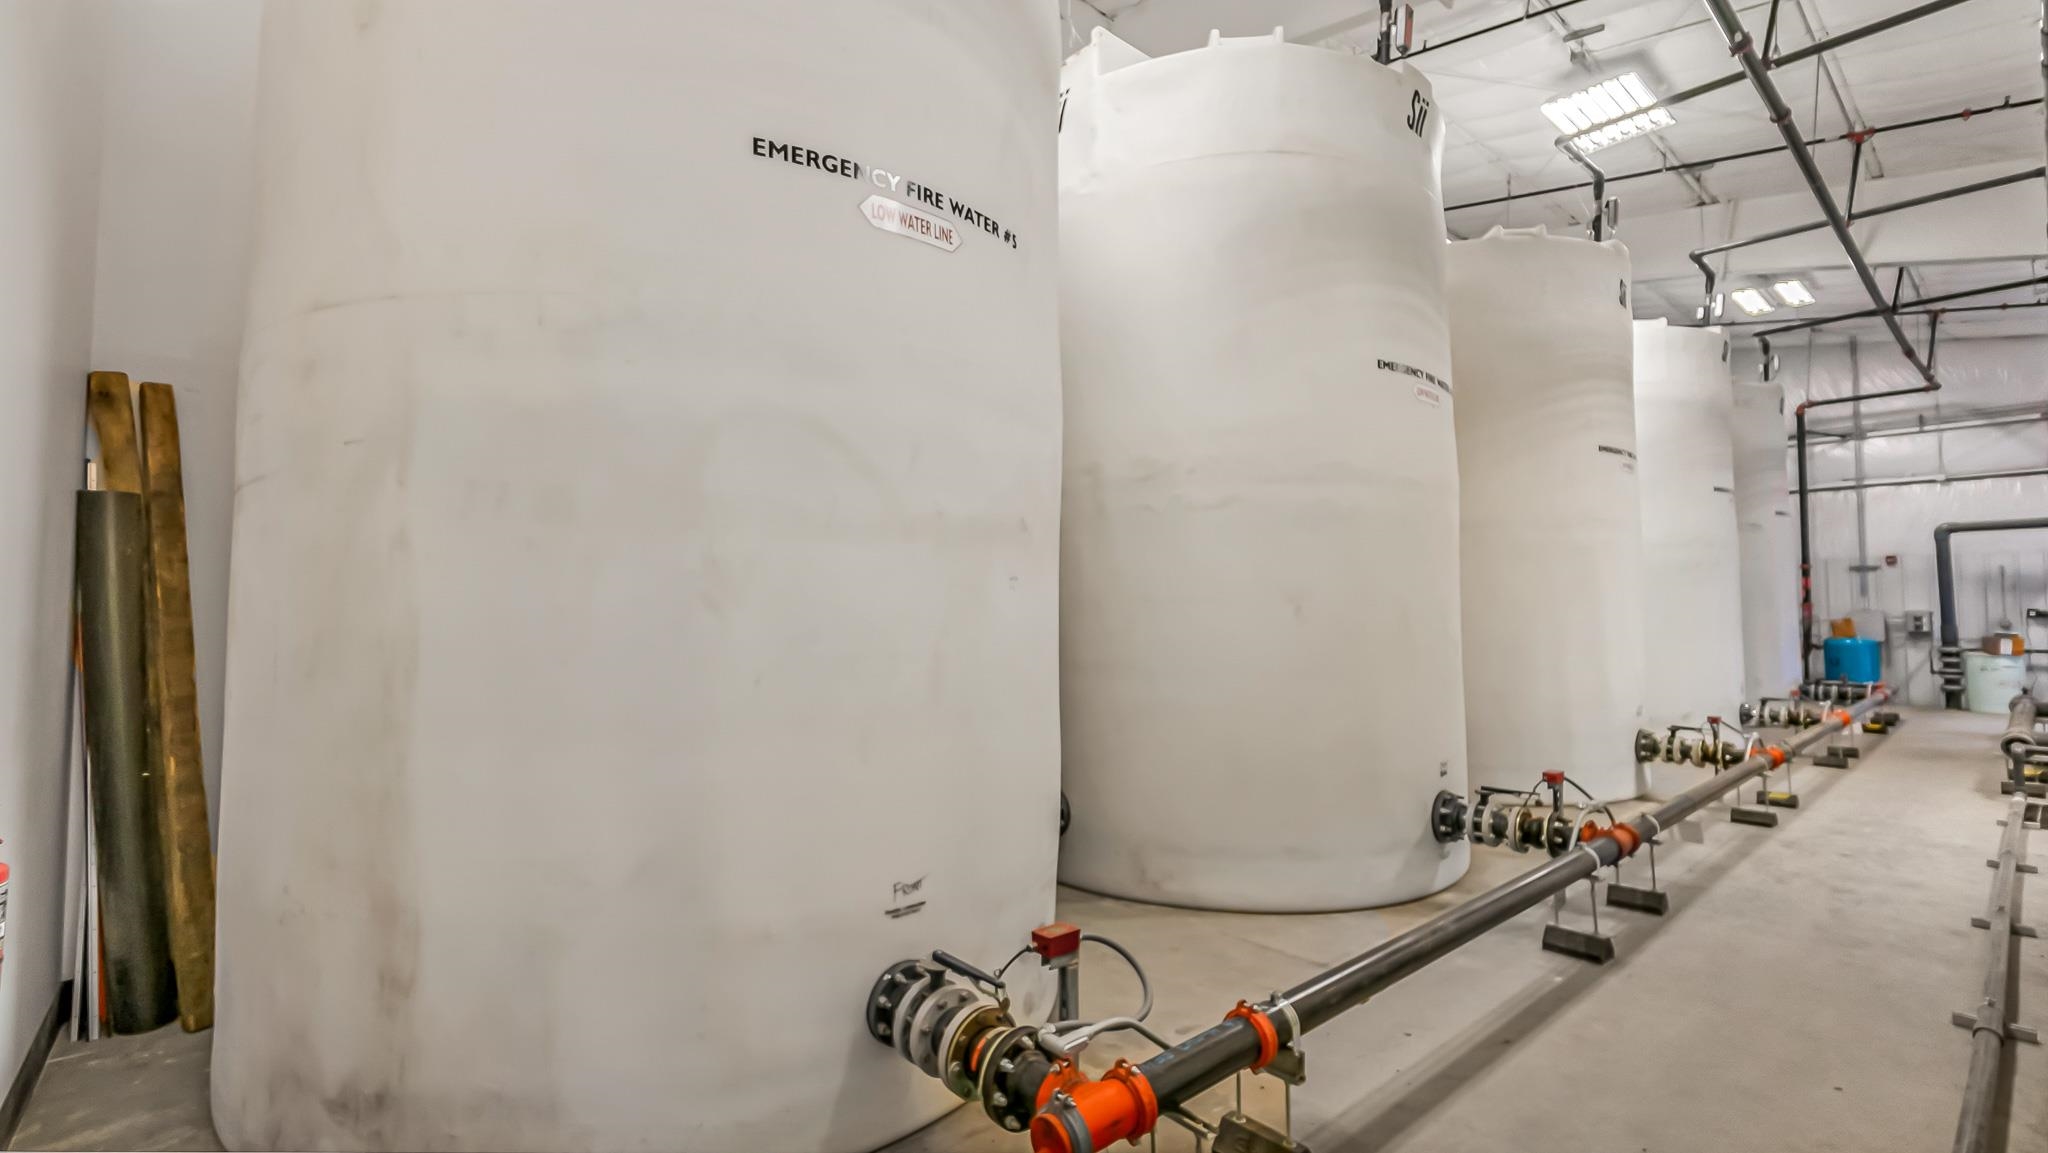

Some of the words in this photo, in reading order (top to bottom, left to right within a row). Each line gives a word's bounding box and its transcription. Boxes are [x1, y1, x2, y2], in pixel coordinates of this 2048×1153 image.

[753, 136, 901, 192] EMERGENCY
[906, 180, 944, 211] FIRE
[949, 197, 1000, 239] WATER
[871, 202, 898, 223] LOW
[899, 210, 932, 237] WATER
[934, 225, 954, 246] LINE
